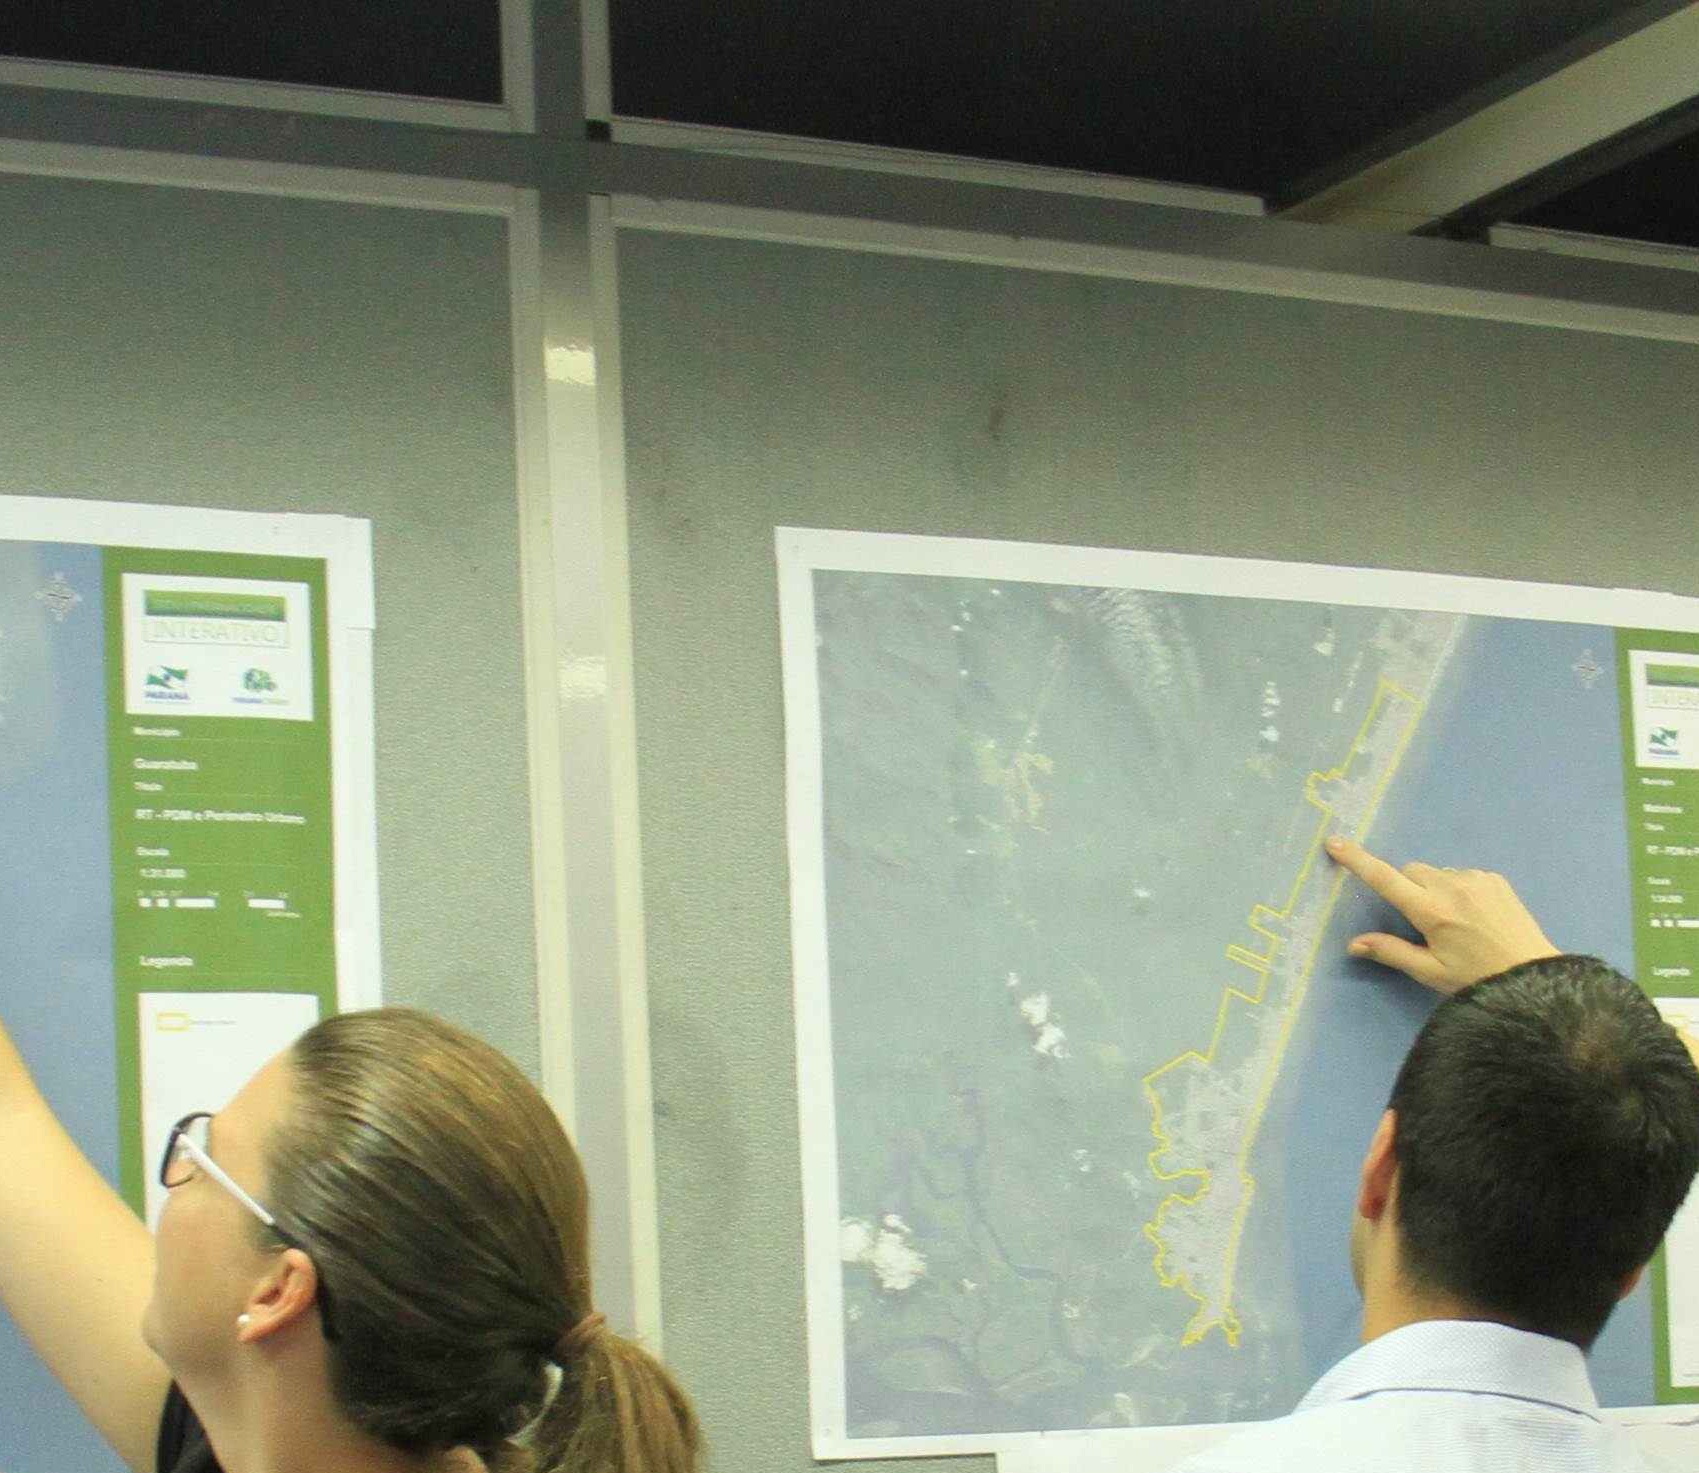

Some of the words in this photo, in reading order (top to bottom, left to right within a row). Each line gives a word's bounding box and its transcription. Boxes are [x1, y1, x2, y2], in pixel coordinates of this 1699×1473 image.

[151, 620, 280, 643] INTERATIVO
[134, 808, 154, 821] RT
[139, 955, 194, 969] Legenda
